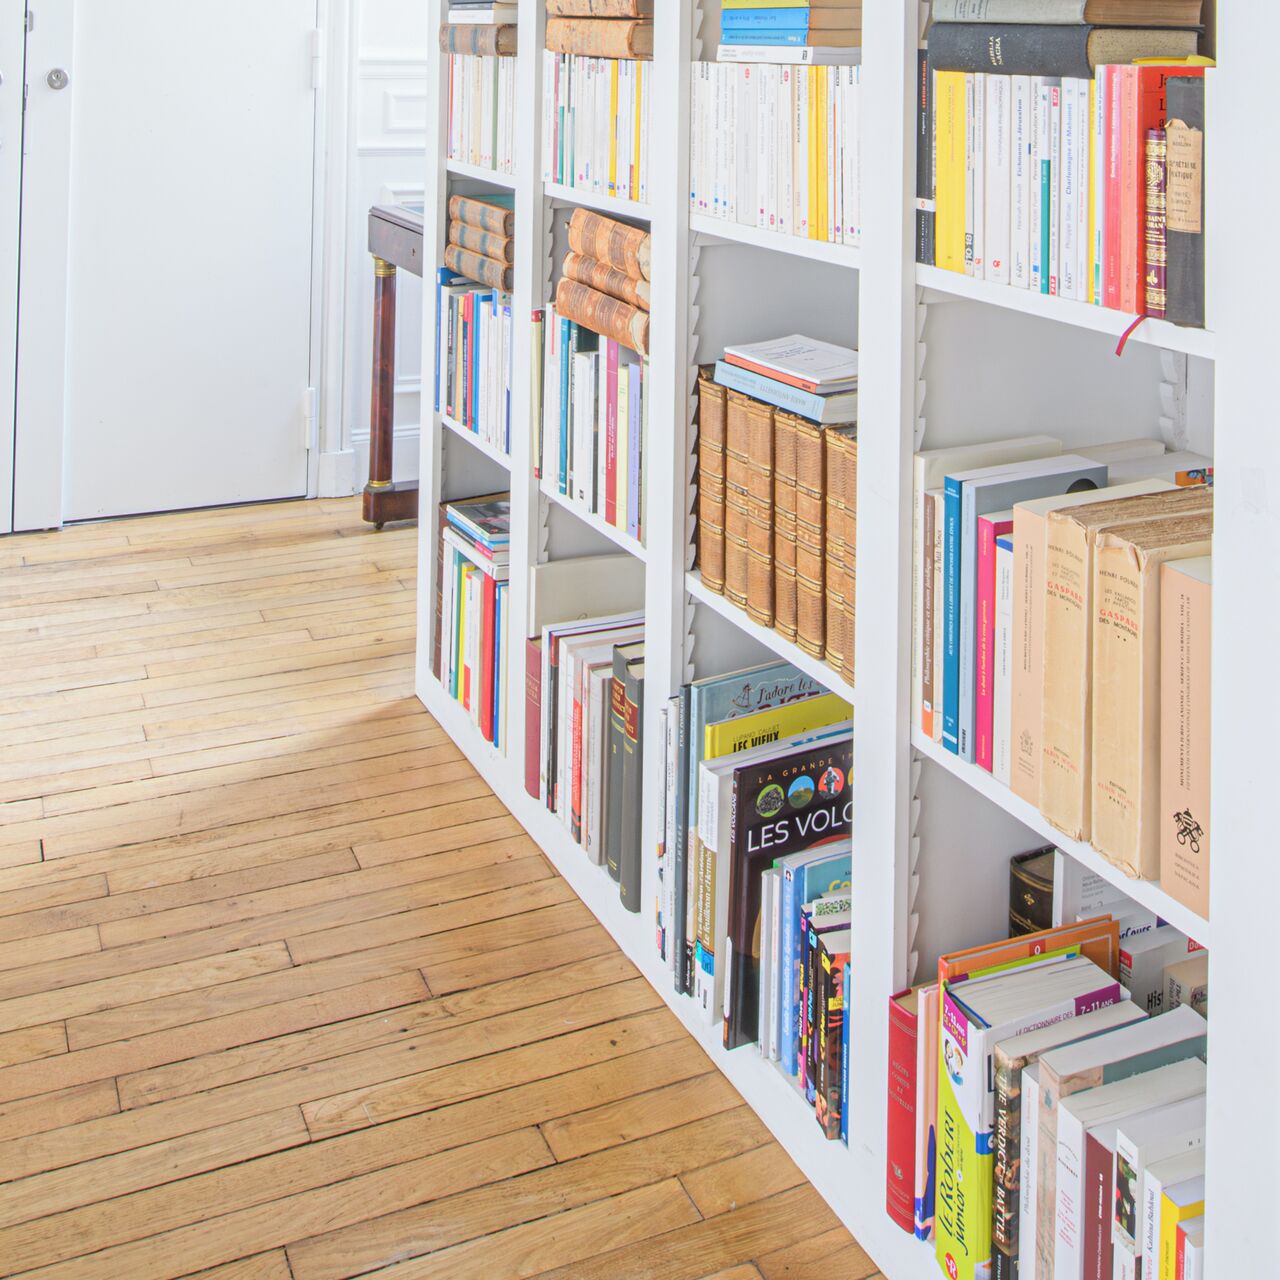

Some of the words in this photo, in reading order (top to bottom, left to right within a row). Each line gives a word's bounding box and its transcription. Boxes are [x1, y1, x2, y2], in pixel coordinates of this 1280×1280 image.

[1047, 581, 1083, 603] GASPARD
[757, 683, 795, 705] J'adore
[798, 679, 814, 690] les
[751, 731, 779, 748] VIEUX
[758, 775, 772, 783] LA
[782, 758, 834, 777] GRANDE
[748, 820, 789, 852] LES
[703, 850, 712, 891] d'Hermès
[702, 893, 713, 933] feuilleton
[703, 935, 711, 945] Le
[1080, 1000, 1100, 1015] 7-11
[1101, 998, 1114, 1008] ANS
[1023, 1014, 1062, 1034] DICTIONNAIRE
[1063, 1011, 1074, 1021] DES
[954, 1183, 969, 1256] junior
